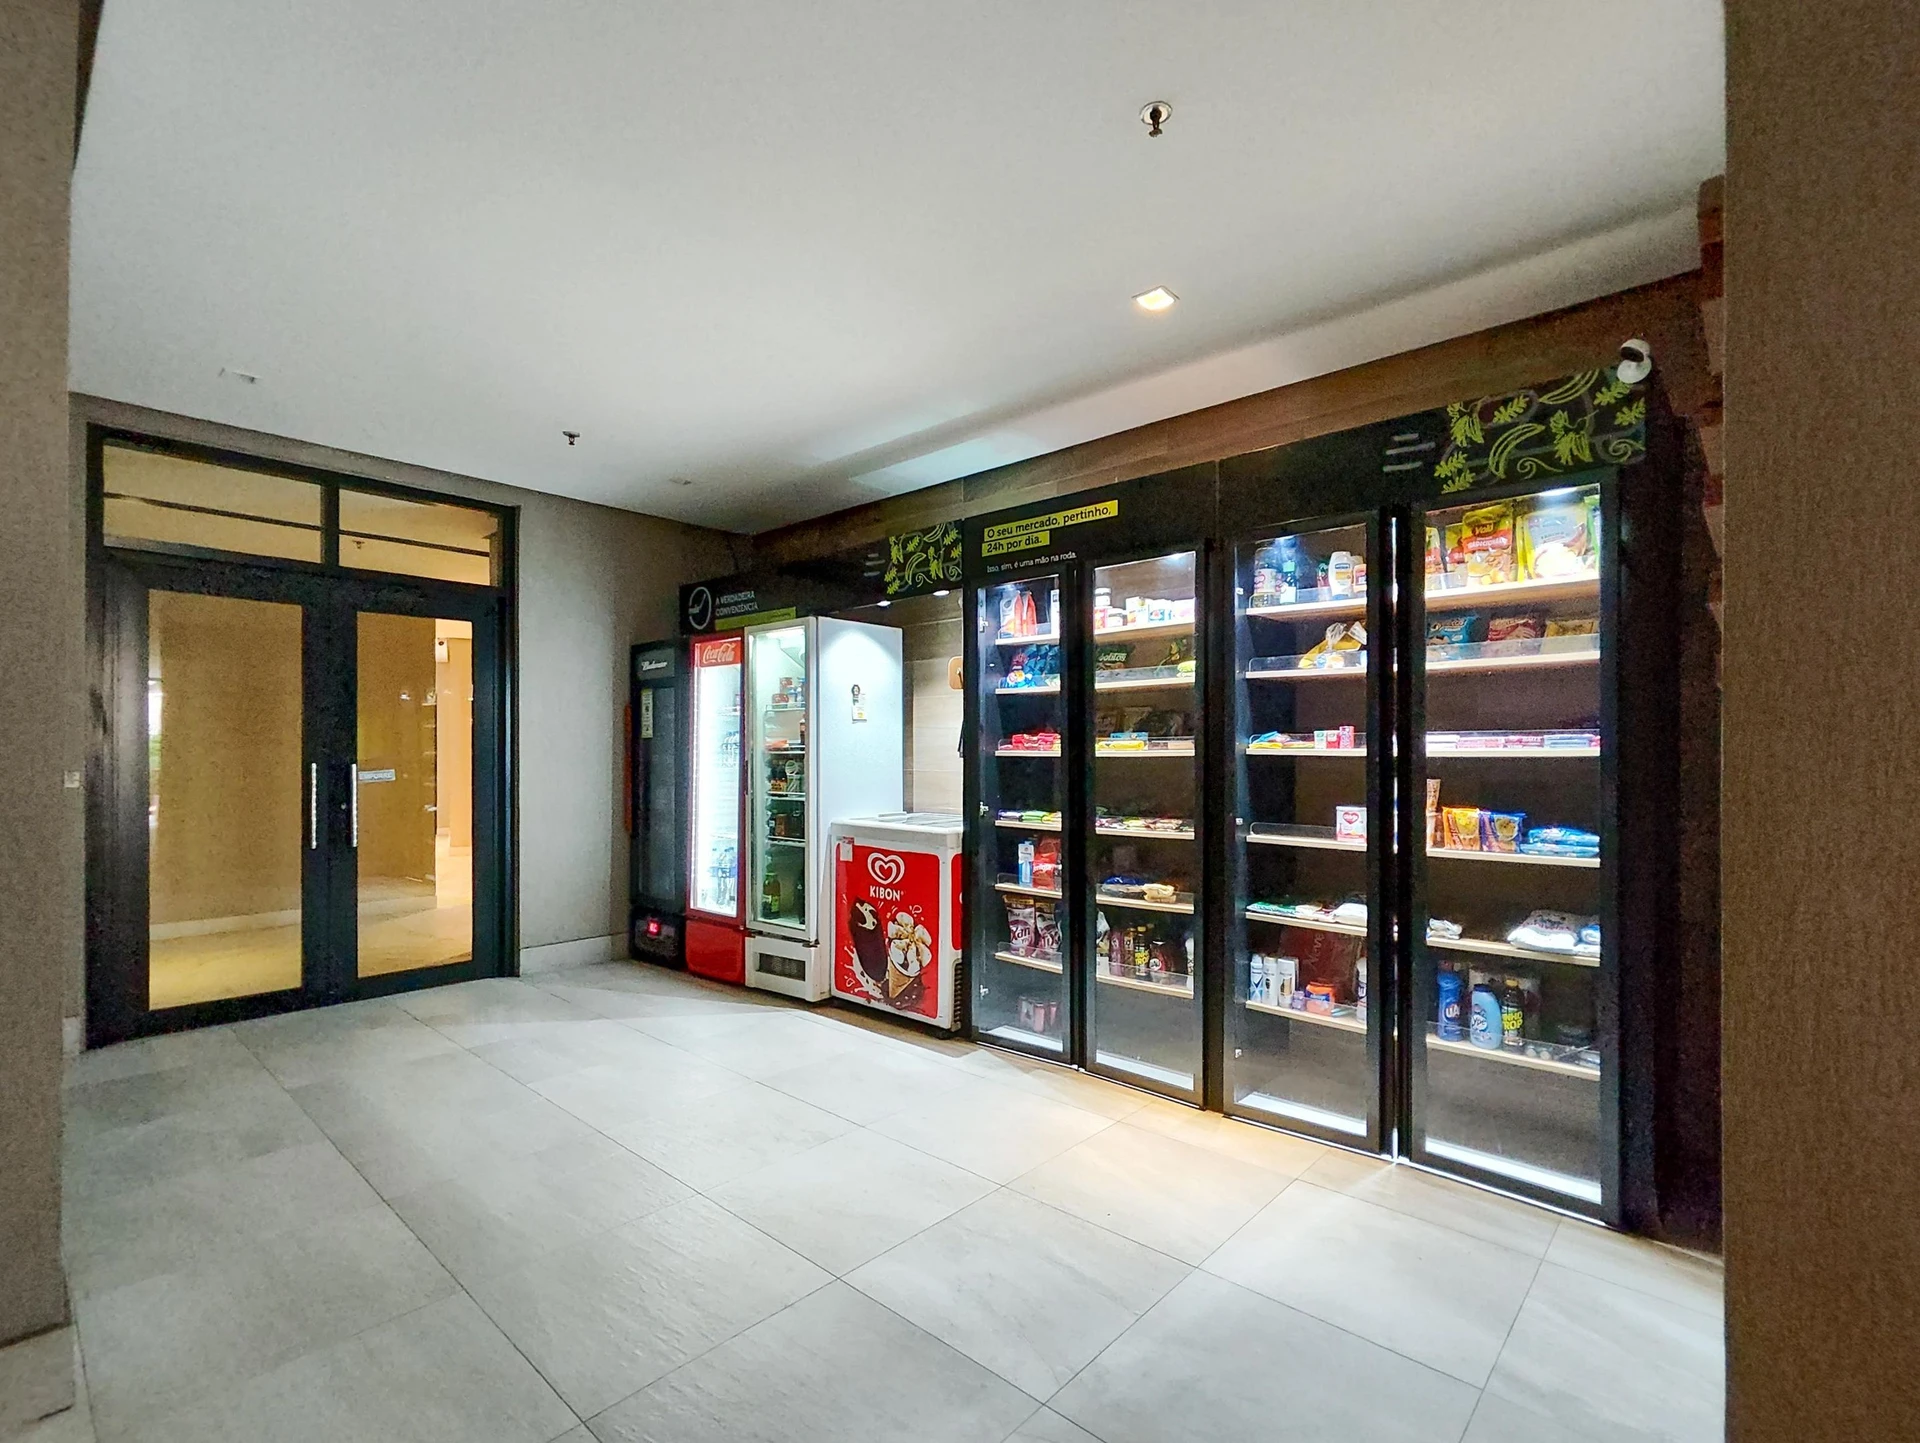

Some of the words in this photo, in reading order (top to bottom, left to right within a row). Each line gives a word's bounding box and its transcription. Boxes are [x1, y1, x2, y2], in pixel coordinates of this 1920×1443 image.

[987, 528, 995, 539] O
[997, 527, 1013, 537] seu
[1015, 516, 1060, 534] mercado,
[1063, 506, 1112, 526] pertinho,
[986, 541, 1005, 553] 24h
[1006, 540, 1022, 552] por
[1025, 535, 1043, 547] dia.
[1020, 558, 1034, 568] uma
[1035, 555, 1050, 566] mão
[1050, 554, 1060, 562] na
[720, 590, 756, 605] VERDADEIRA
[870, 885, 901, 902] KIBON
